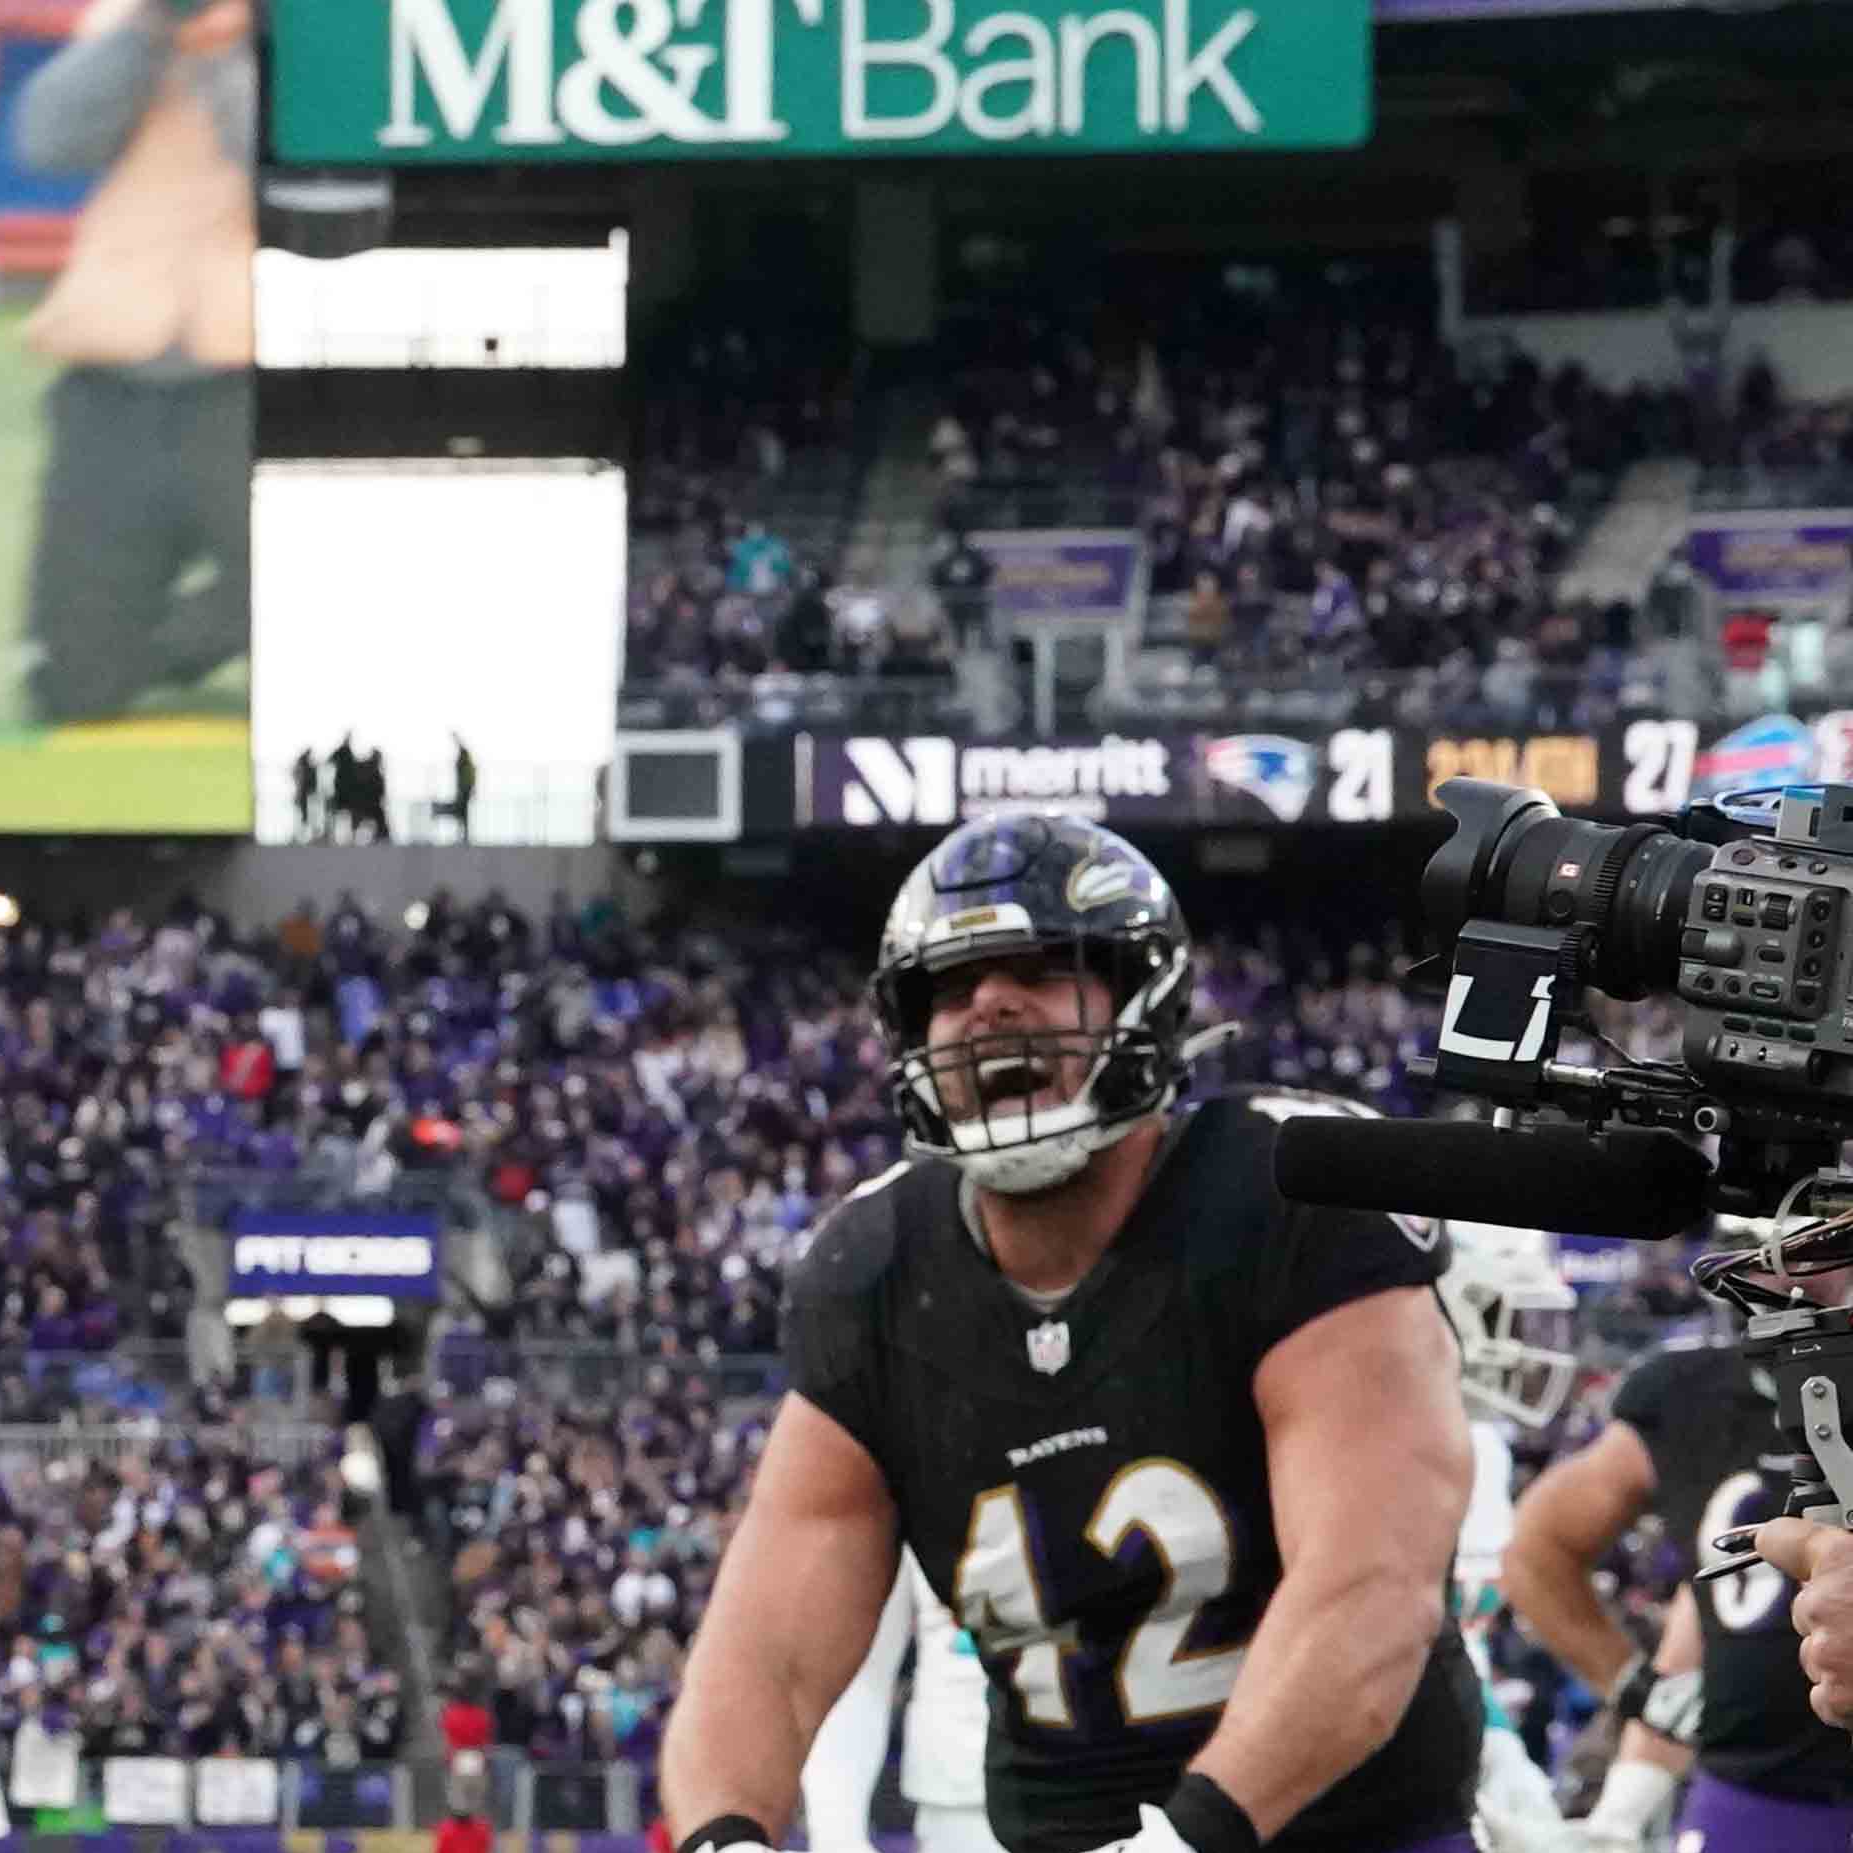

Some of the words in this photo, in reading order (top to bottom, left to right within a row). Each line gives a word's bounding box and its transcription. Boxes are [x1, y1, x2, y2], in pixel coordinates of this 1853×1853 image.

[376, 0, 821, 146] M&T
[840, 0, 1263, 140] Bank
[953, 1456, 1250, 1729] 42
